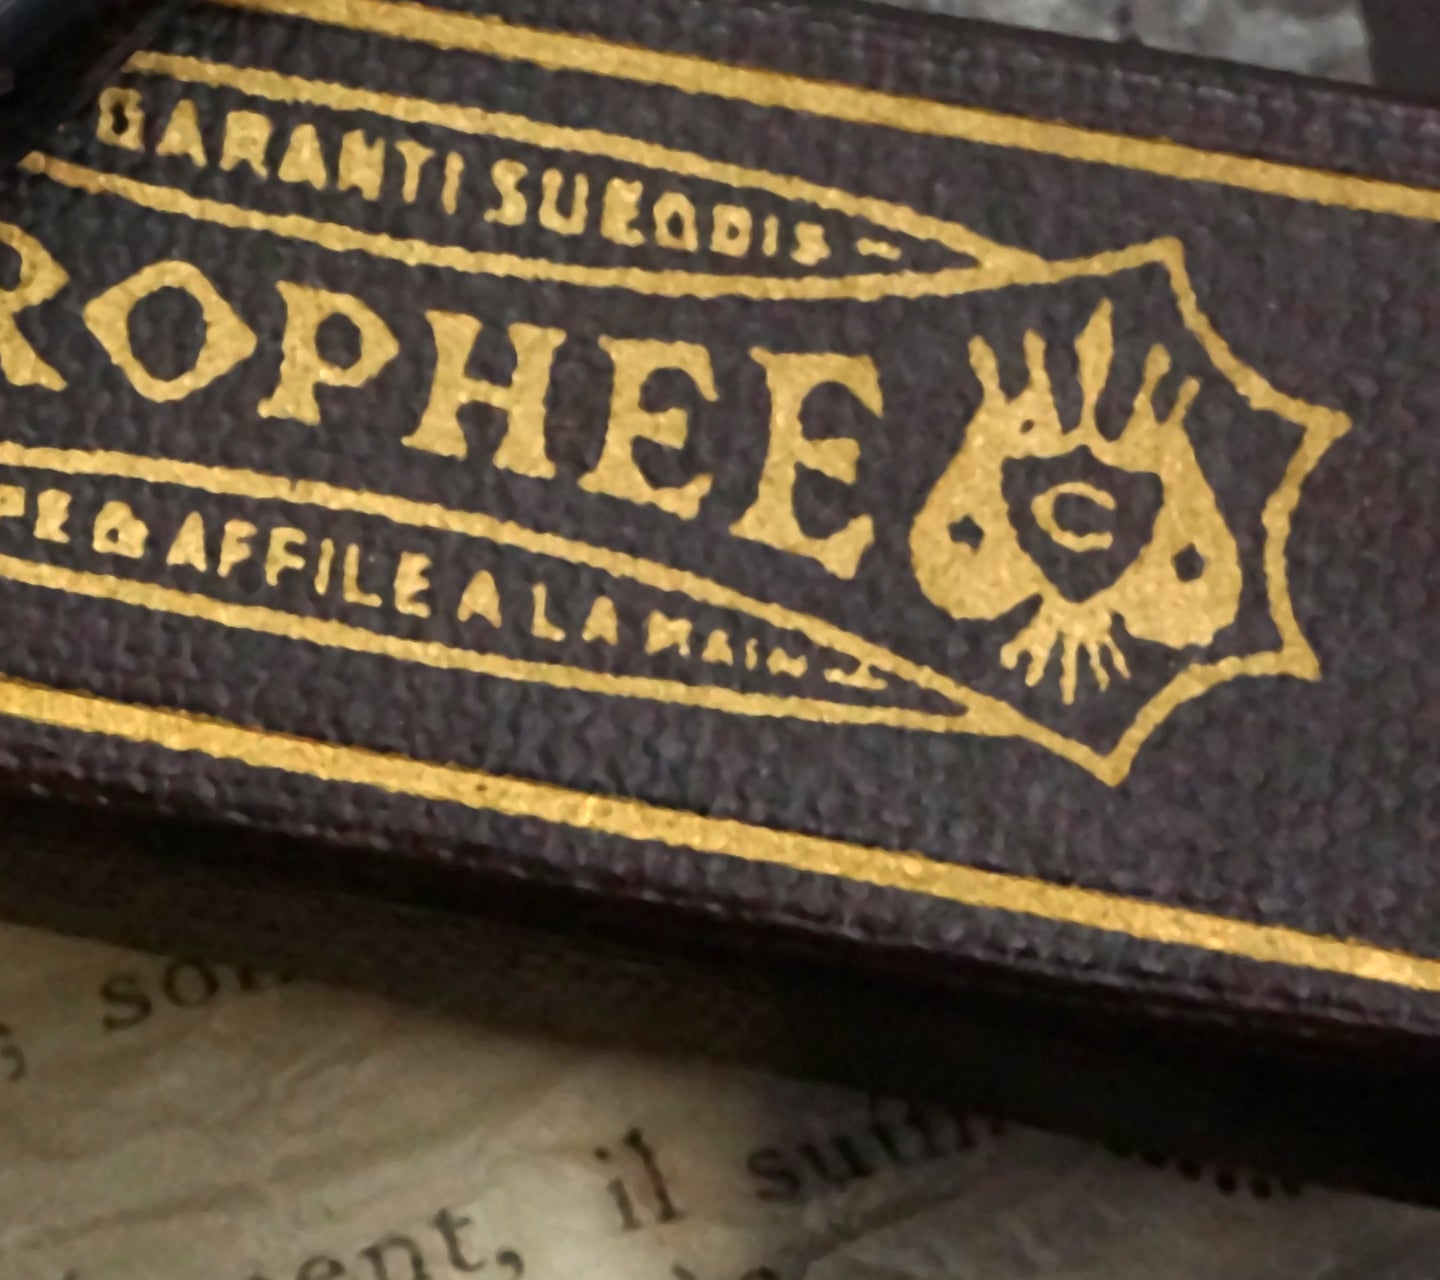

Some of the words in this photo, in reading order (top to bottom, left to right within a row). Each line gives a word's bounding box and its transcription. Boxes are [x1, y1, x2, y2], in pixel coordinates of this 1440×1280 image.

[95, 85, 465, 217] GARANTI
[1030, 481, 1117, 553] C
[165, 511, 432, 618] AFFILE
[456, 570, 503, 629] A
[530, 582, 619, 647] LA
[644, 609, 809, 678] MAIN
[593, 1127, 687, 1232] il
